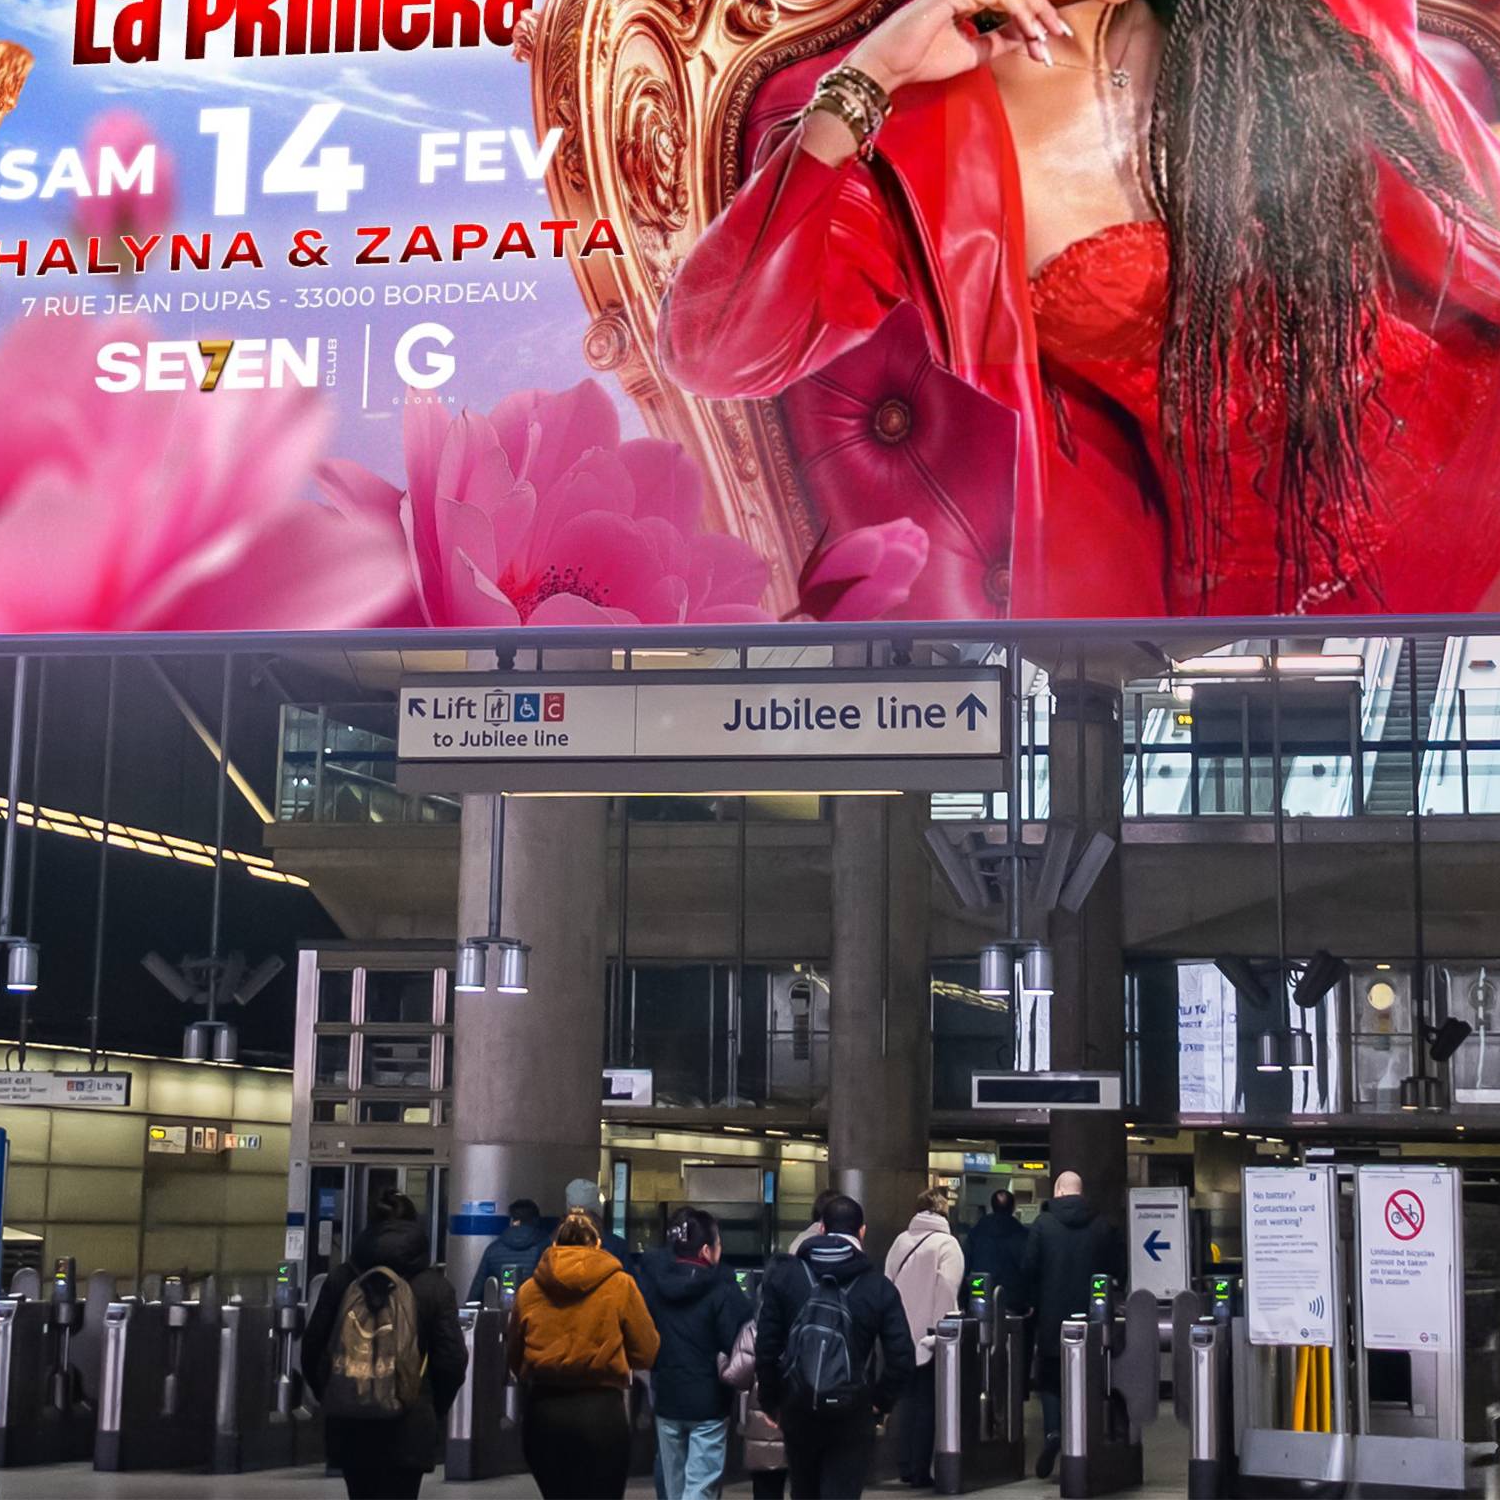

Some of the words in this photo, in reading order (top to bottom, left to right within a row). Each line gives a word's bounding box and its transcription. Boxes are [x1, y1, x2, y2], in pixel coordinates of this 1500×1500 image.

[199, 102, 364, 216] 14
[418, 127, 564, 185] FEV
[287, 228, 332, 268] &
[354, 218, 627, 266] ZAPATA
[21, 298, 36, 317] 7
[44, 296, 97, 317] RUE
[103, 293, 171, 316] JEAN
[181, 290, 272, 312] DUPAS
[294, 286, 375, 309] 33000
[385, 281, 538, 307] BORDEAUX
[326, 338, 338, 387] CLUB
[394, 322, 456, 389] G
[433, 697, 477, 719] Lift
[548, 703, 560, 718] C
[723, 697, 861, 731] Jubilee
[877, 696, 947, 729] line
[433, 732, 453, 748] to
[459, 730, 528, 748] Jubilee
[534, 730, 569, 747] line
[1253, 1191, 1264, 1200] No
